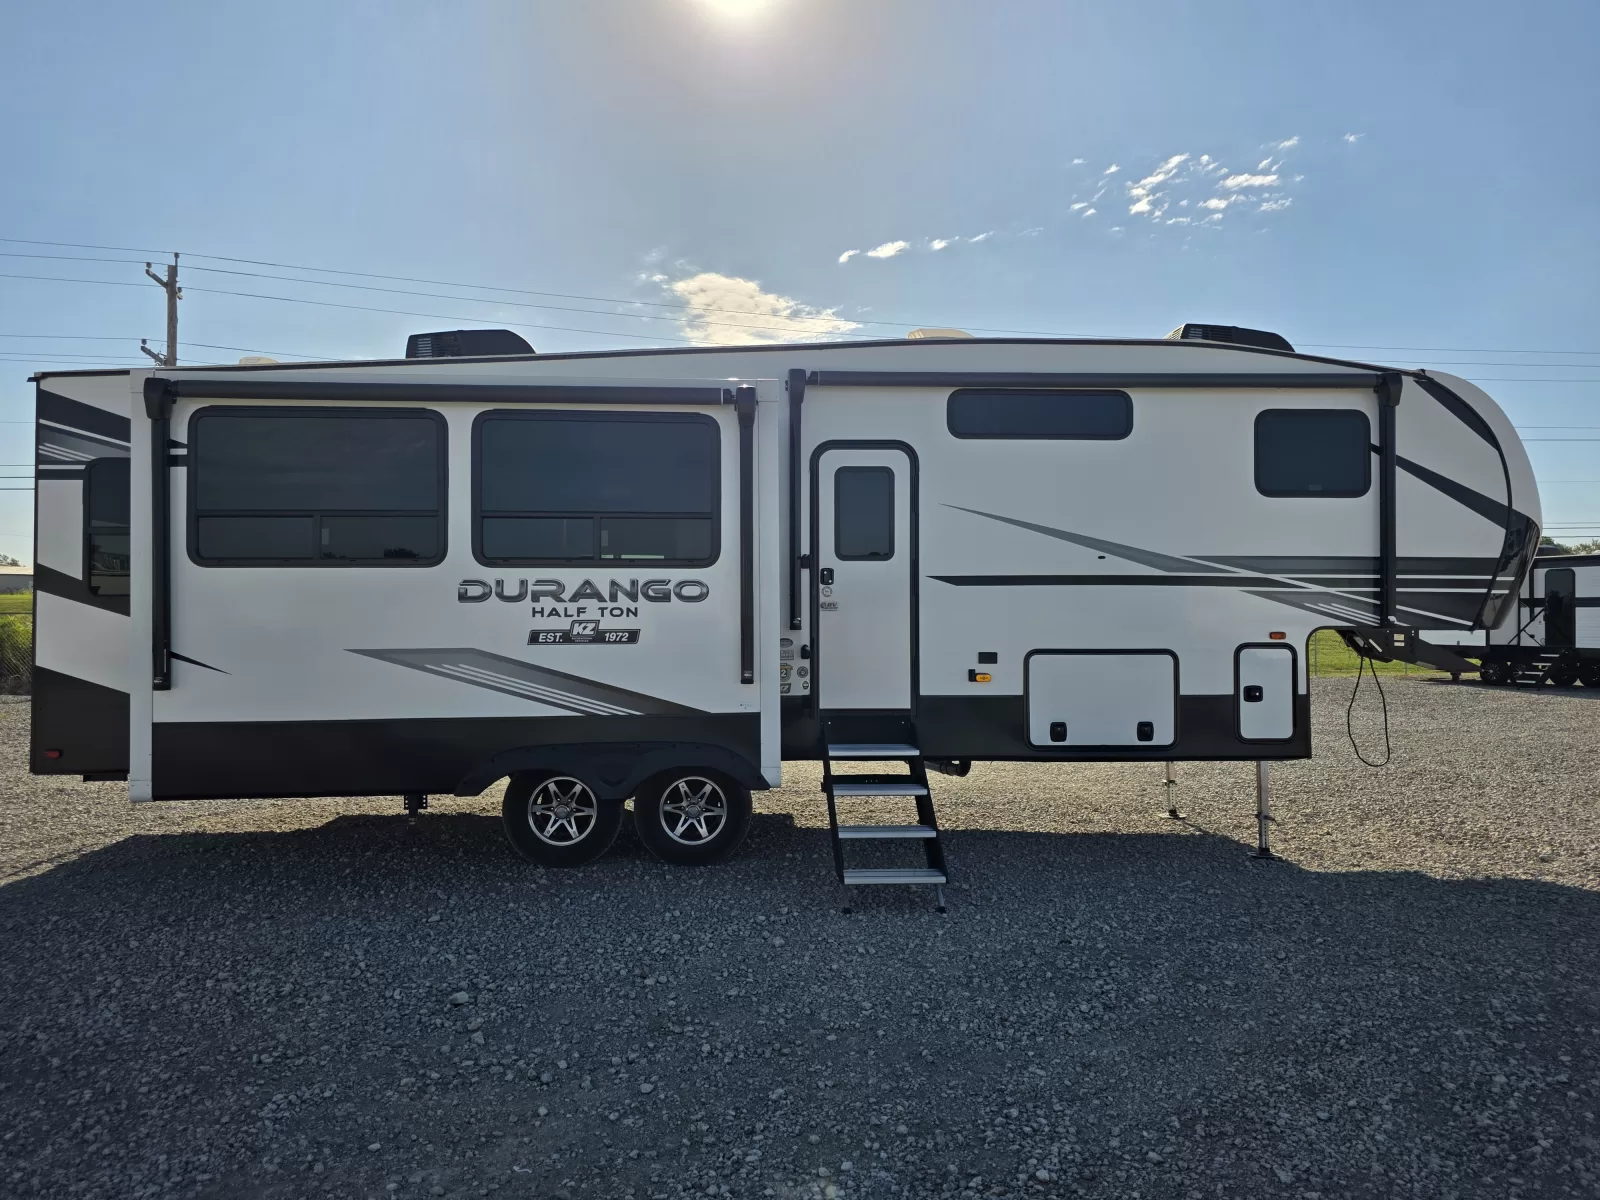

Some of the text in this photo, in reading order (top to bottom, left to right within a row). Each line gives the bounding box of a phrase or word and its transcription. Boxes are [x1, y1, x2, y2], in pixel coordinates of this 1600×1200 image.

[458, 578, 709, 603] DURANGO
[532, 607, 638, 618] HALF TON
[572, 622, 596, 635] KZ
[538, 633, 563, 642] EST.
[604, 632, 629, 642] 1972
